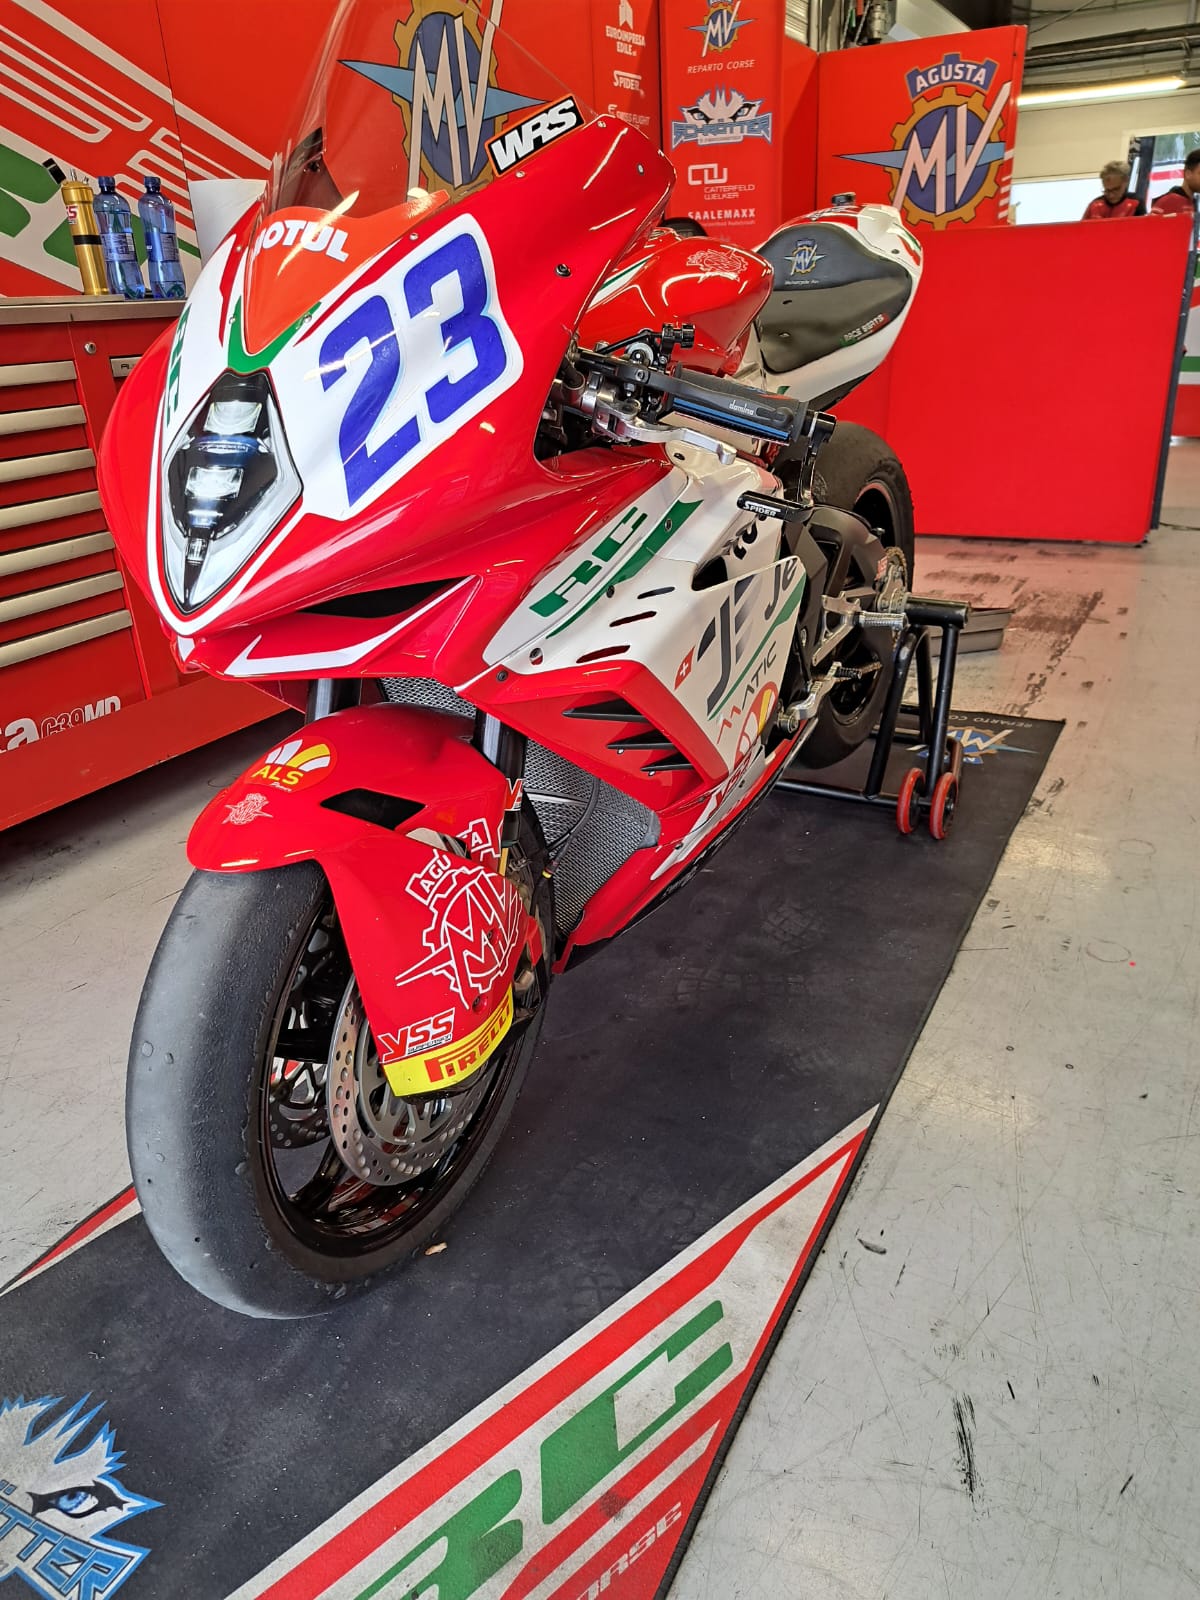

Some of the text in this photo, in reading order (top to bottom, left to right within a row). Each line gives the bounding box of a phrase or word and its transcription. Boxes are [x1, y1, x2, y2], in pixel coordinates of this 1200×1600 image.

[687, 59, 756, 74] REPARTO CORSE
[914, 63, 988, 94] AGUSTA
[490, 99, 577, 171] WRS
[688, 208, 756, 220] SAALEMAXX
[319, 232, 507, 508] 23
[728, 399, 755, 416] domino
[743, 500, 782, 517] SPIDER
[251, 765, 304, 785] ALS
[378, 1006, 456, 1064] YSS
[423, 992, 511, 1084] PIRELLI
[0, 1501, 137, 1600] TTER
